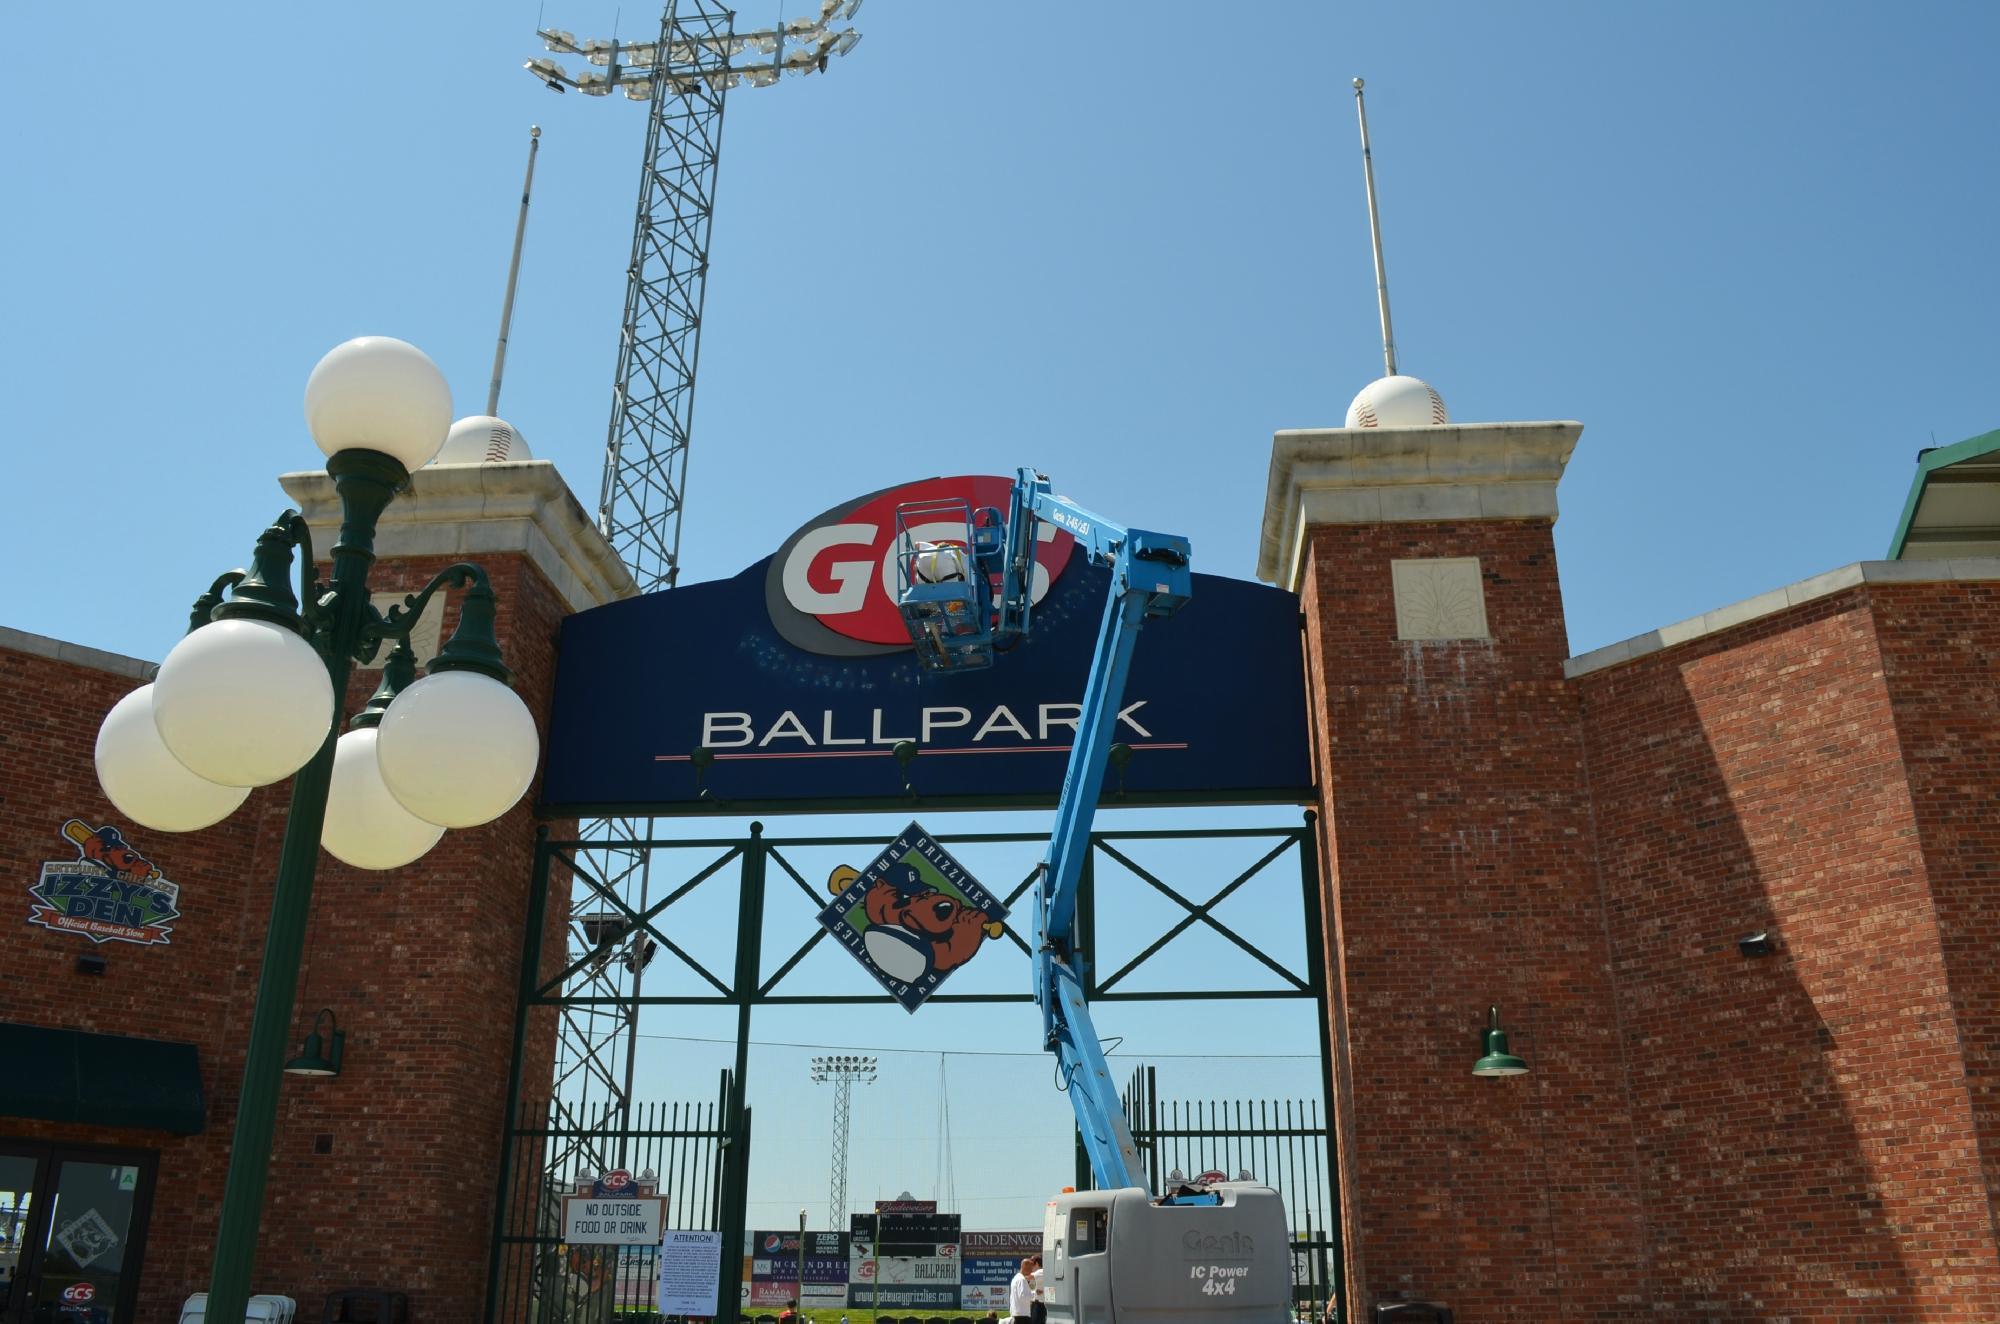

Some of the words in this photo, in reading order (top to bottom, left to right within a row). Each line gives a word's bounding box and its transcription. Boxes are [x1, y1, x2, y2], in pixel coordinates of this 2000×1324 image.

[835, 839, 910, 913] GATEWAY
[917, 838, 991, 909] GRIZZLIES
[42, 874, 174, 915] IZZY'S
[66, 896, 144, 928] DEN
[57, 917, 88, 930] Official
[90, 922, 124, 936] Baseball
[126, 927, 145, 939] Store
[122, 1174, 133, 1184] A
[603, 1175, 629, 1187] GCS
[586, 1204, 598, 1216] NO
[602, 1203, 642, 1216] OUTSIDE
[575, 1221, 600, 1234] FOOD
[604, 1221, 616, 1234] OR
[620, 1221, 648, 1234] DRINK
[673, 1234, 714, 1243] ATTENTION!
[816, 1233, 839, 1241] ZERO
[939, 1247, 956, 1255] GCS
[914, 1264, 957, 1279] BALLPARK
[1191, 1266, 1206, 1279] IC
[1209, 1265, 1249, 1278] Power
[63, 1287, 94, 1300] GCS
[1202, 1278, 1236, 1296] 4x4
